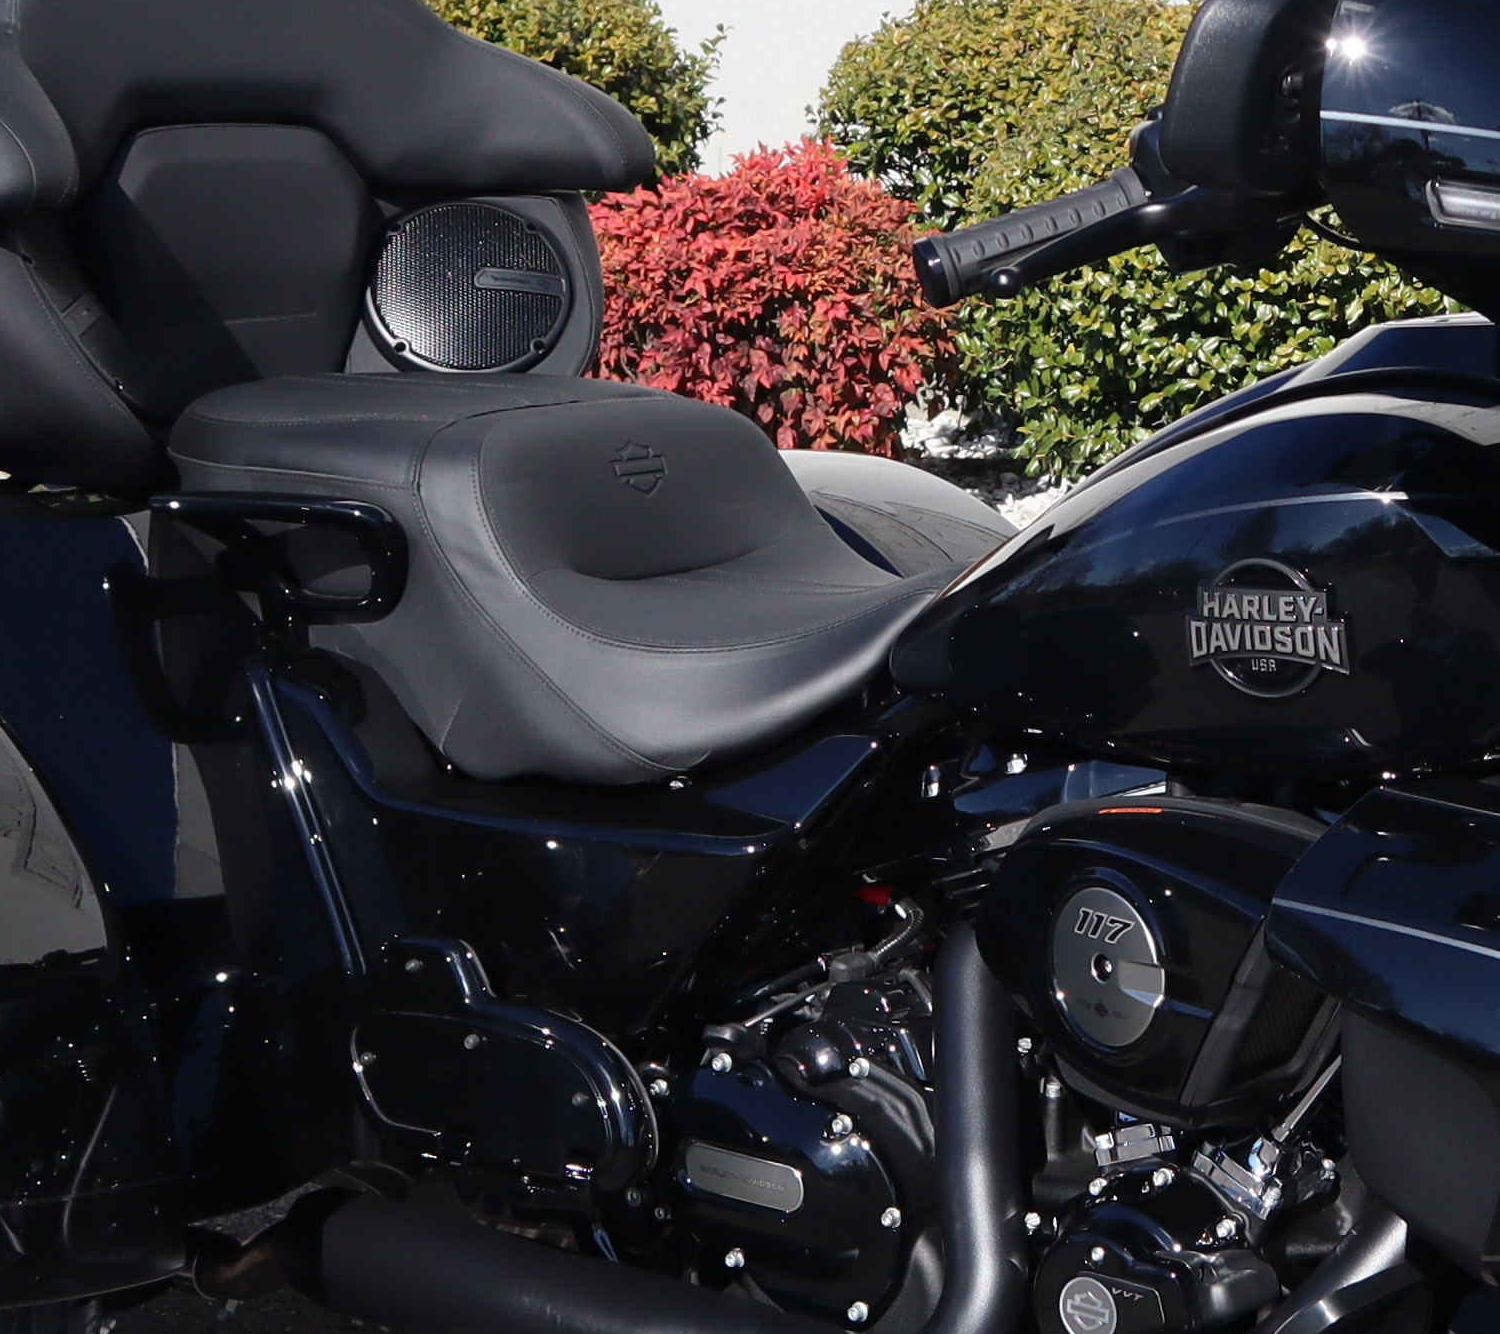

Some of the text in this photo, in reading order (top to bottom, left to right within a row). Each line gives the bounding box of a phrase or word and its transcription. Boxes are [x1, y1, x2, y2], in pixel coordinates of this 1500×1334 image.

[1202, 590, 1324, 624] HARLEY-
[1189, 618, 1344, 666] DAVIDSON
[1250, 657, 1277, 673] USA
[1073, 906, 1135, 945] 117
[1111, 1286, 1144, 1302] VVT
